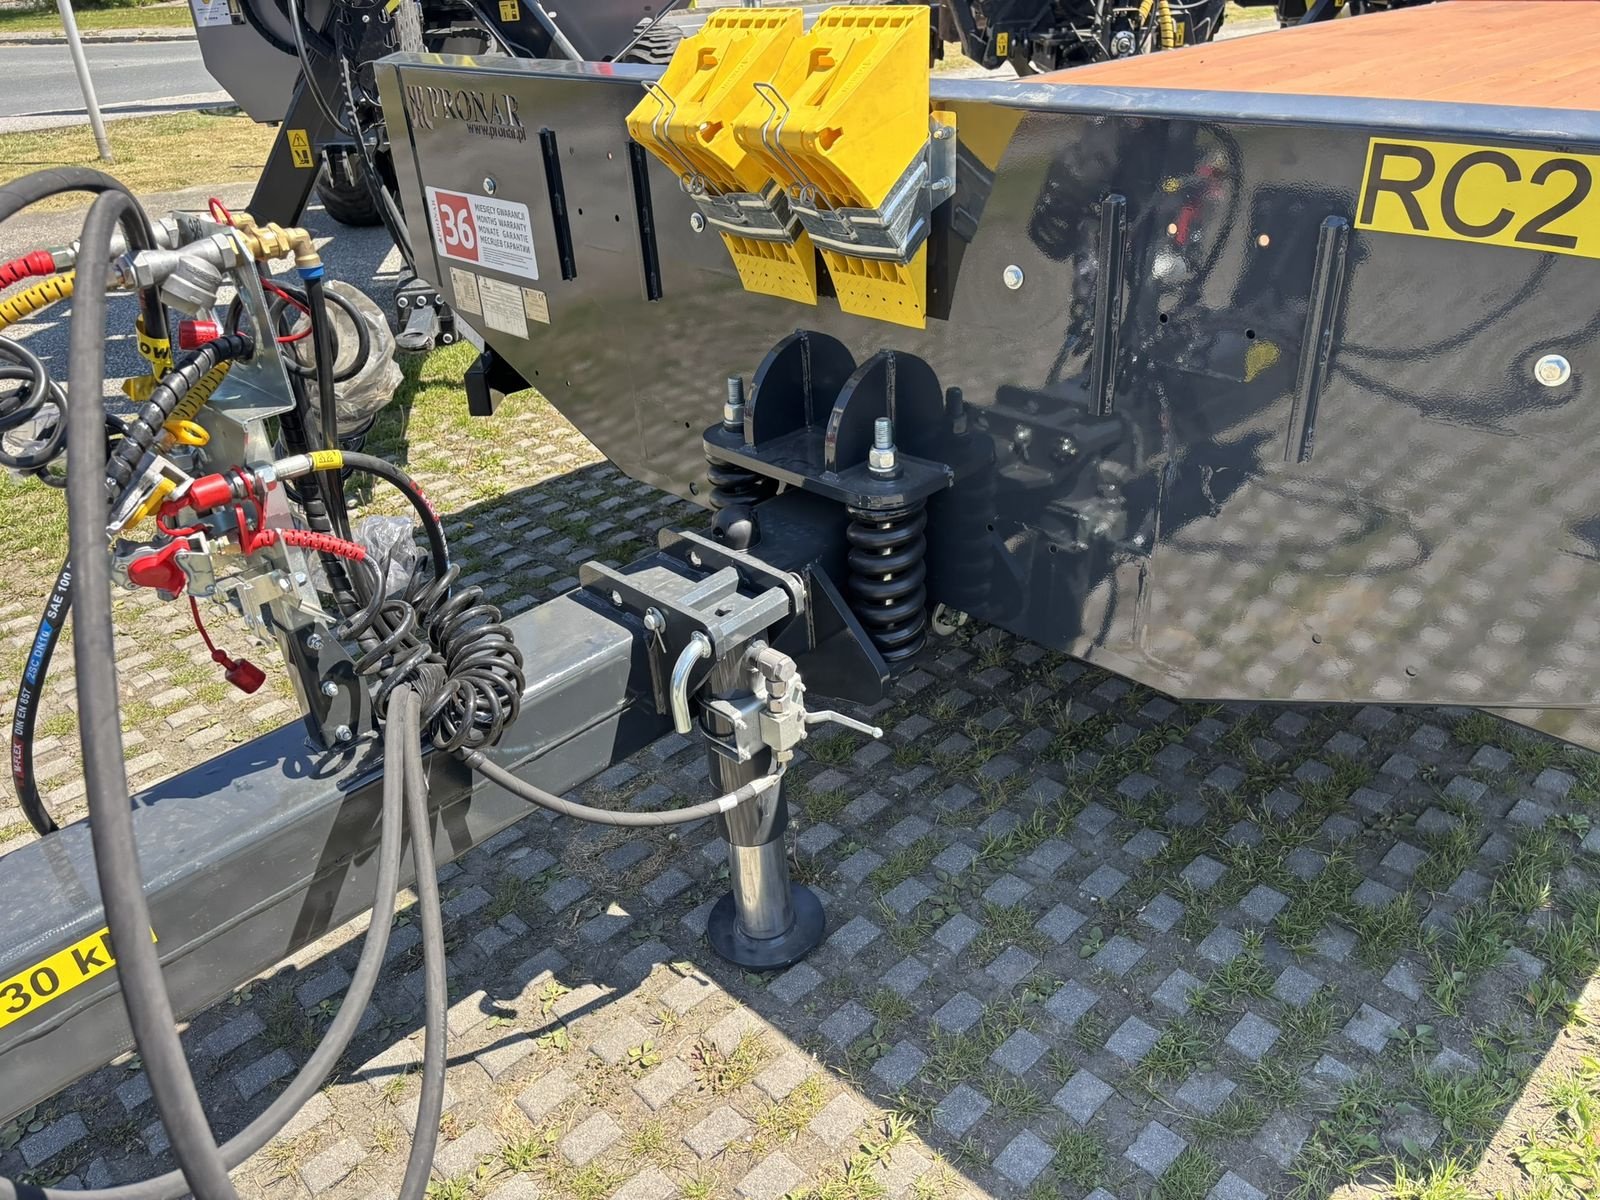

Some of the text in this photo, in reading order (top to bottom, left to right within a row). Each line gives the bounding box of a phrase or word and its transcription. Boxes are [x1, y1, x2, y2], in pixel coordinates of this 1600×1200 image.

[427, 86, 524, 127] PRONAR
[467, 122, 527, 143] www.pronar.pl
[1360, 143, 1592, 249] RC2
[439, 203, 475, 250] 36
[476, 214, 527, 233] MONTHS WARRANTY
[478, 225, 529, 244] MONATE GARANTIE
[57, 572, 72, 592] 100
[47, 594, 64, 619] SAE
[26, 660, 40, 679] 2SC
[20, 689, 32, 705] 857
[17, 705, 28, 719] EN
[15, 719, 25, 735] DIN
[0, 966, 60, 1013] 30
